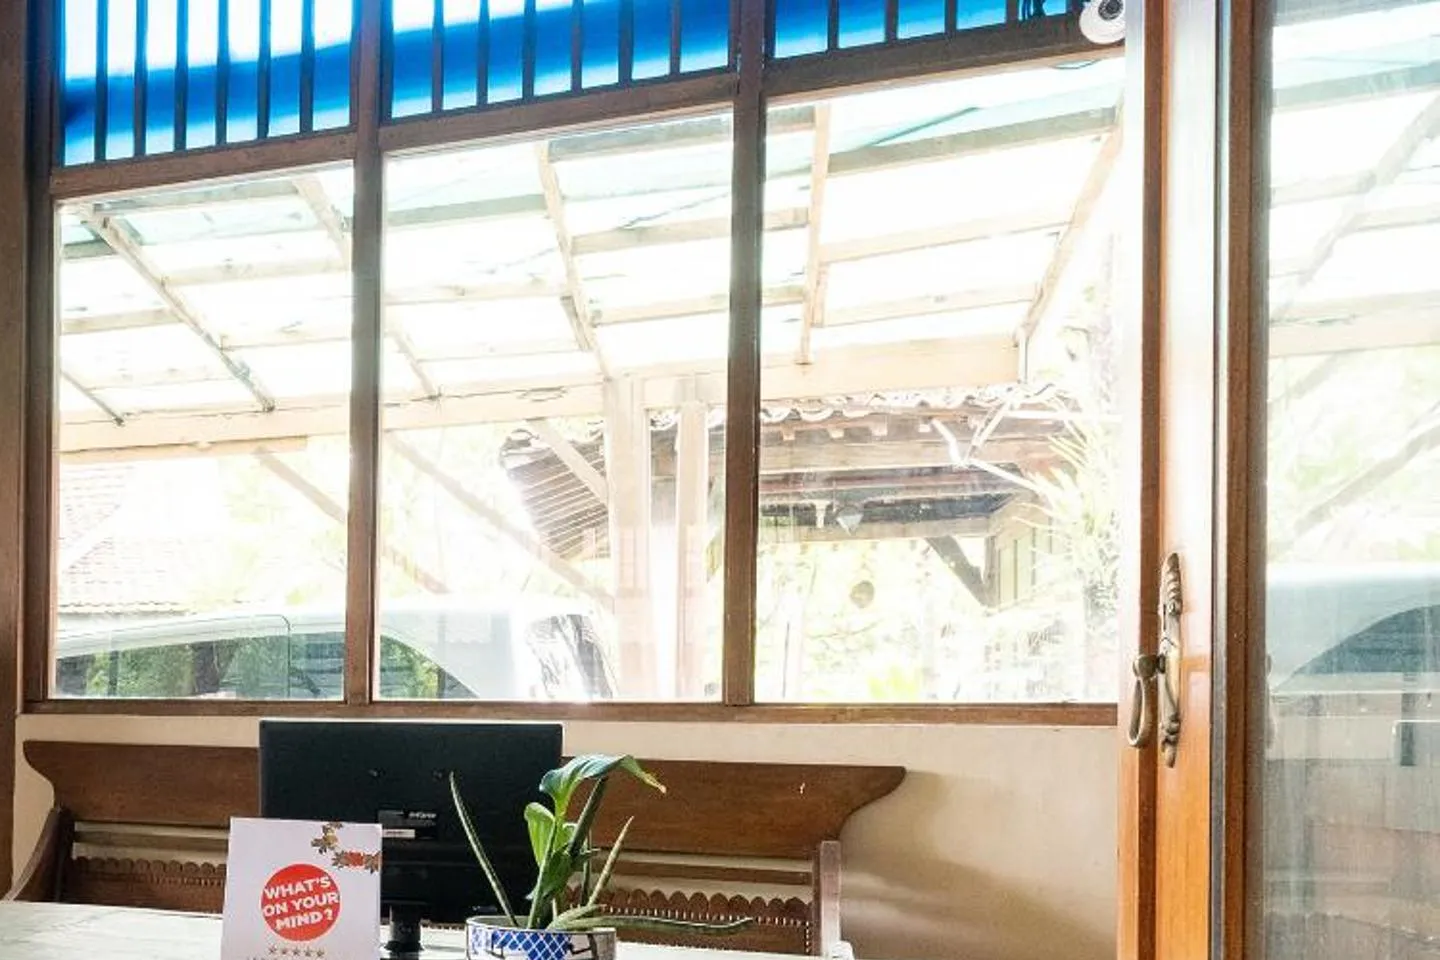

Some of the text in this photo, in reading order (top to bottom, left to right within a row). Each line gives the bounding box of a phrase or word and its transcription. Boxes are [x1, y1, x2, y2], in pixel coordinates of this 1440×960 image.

[264, 876, 331, 899] WHAT'S
[263, 892, 339, 917] ON YOUR
